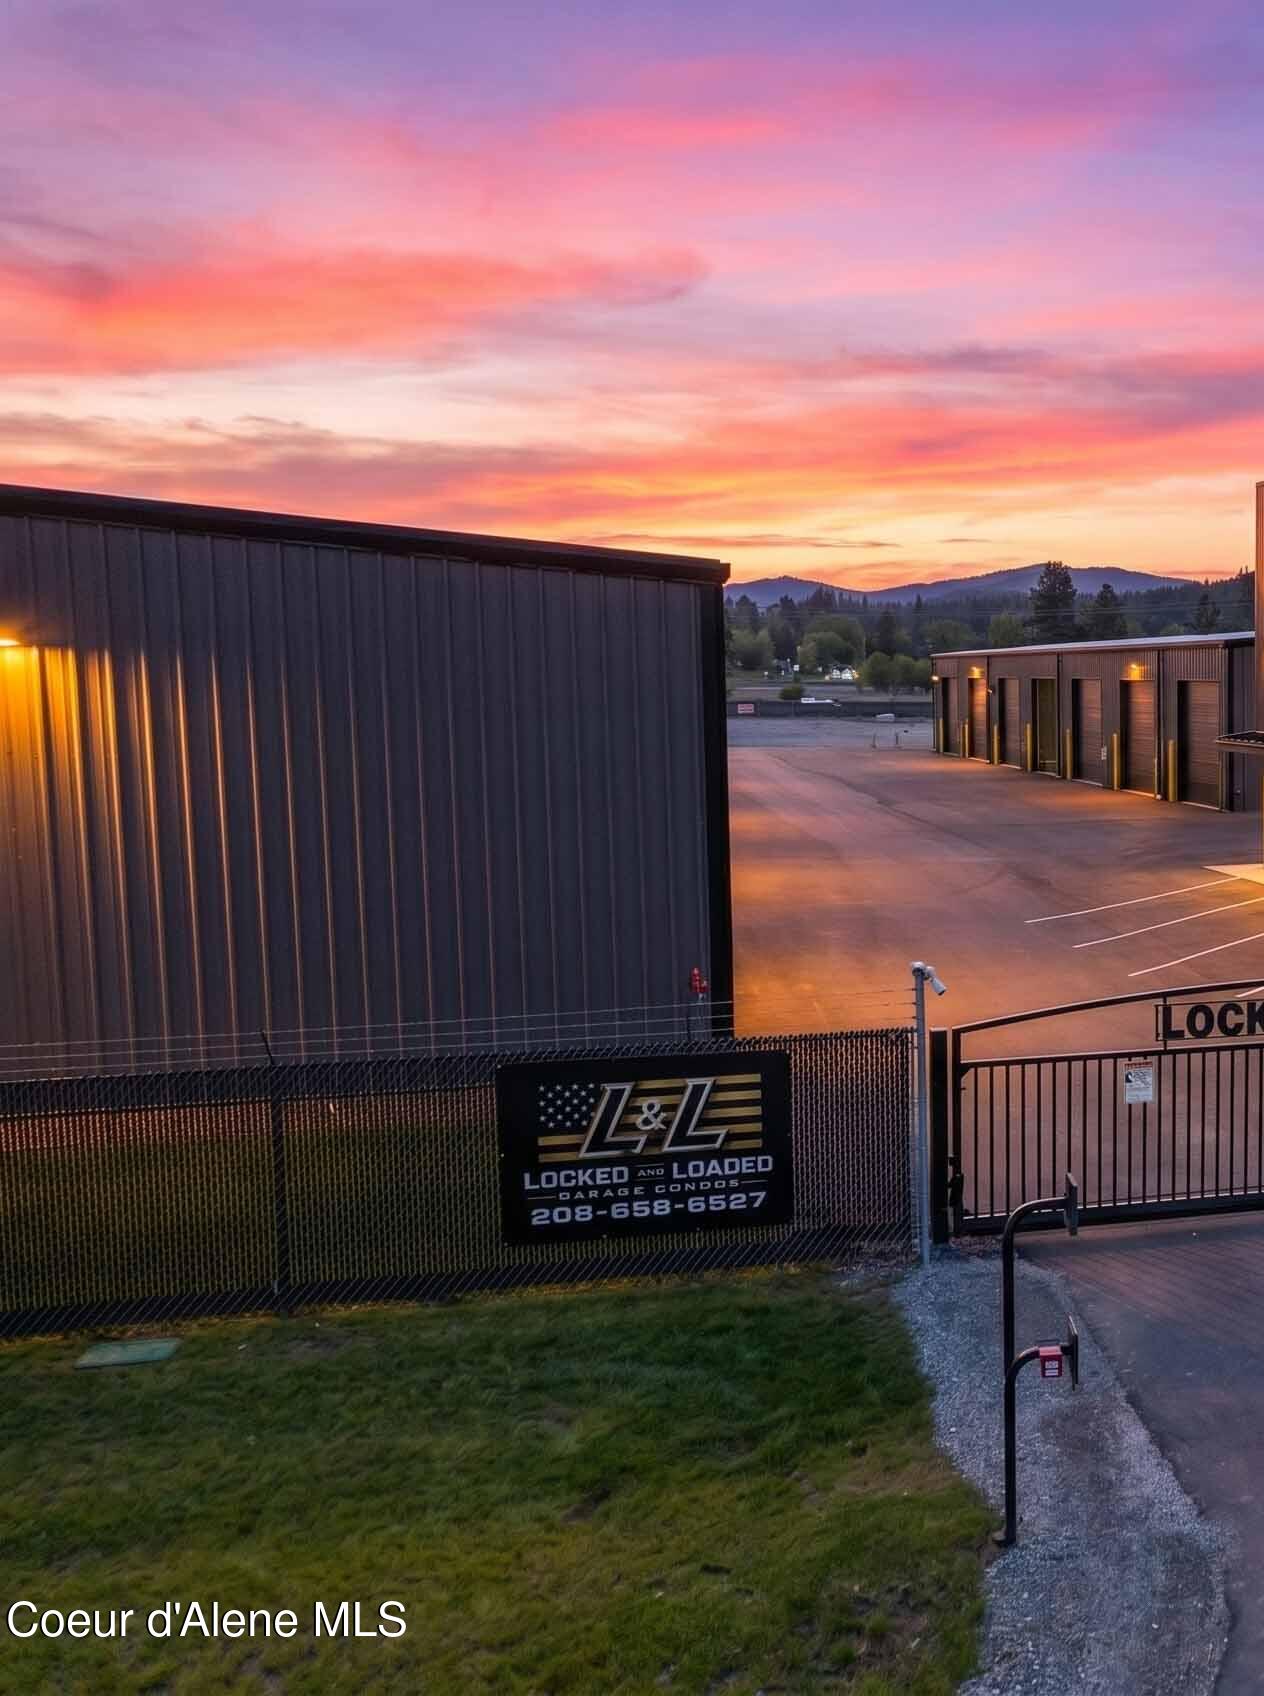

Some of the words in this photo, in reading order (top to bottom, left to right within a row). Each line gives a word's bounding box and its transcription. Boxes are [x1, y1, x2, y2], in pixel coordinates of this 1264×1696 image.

[523, 1166, 629, 1190] LOCKED
[637, 1168, 665, 1177] AND
[672, 1155, 773, 1179] LOADED
[530, 1191, 767, 1226] 208-658-6527
